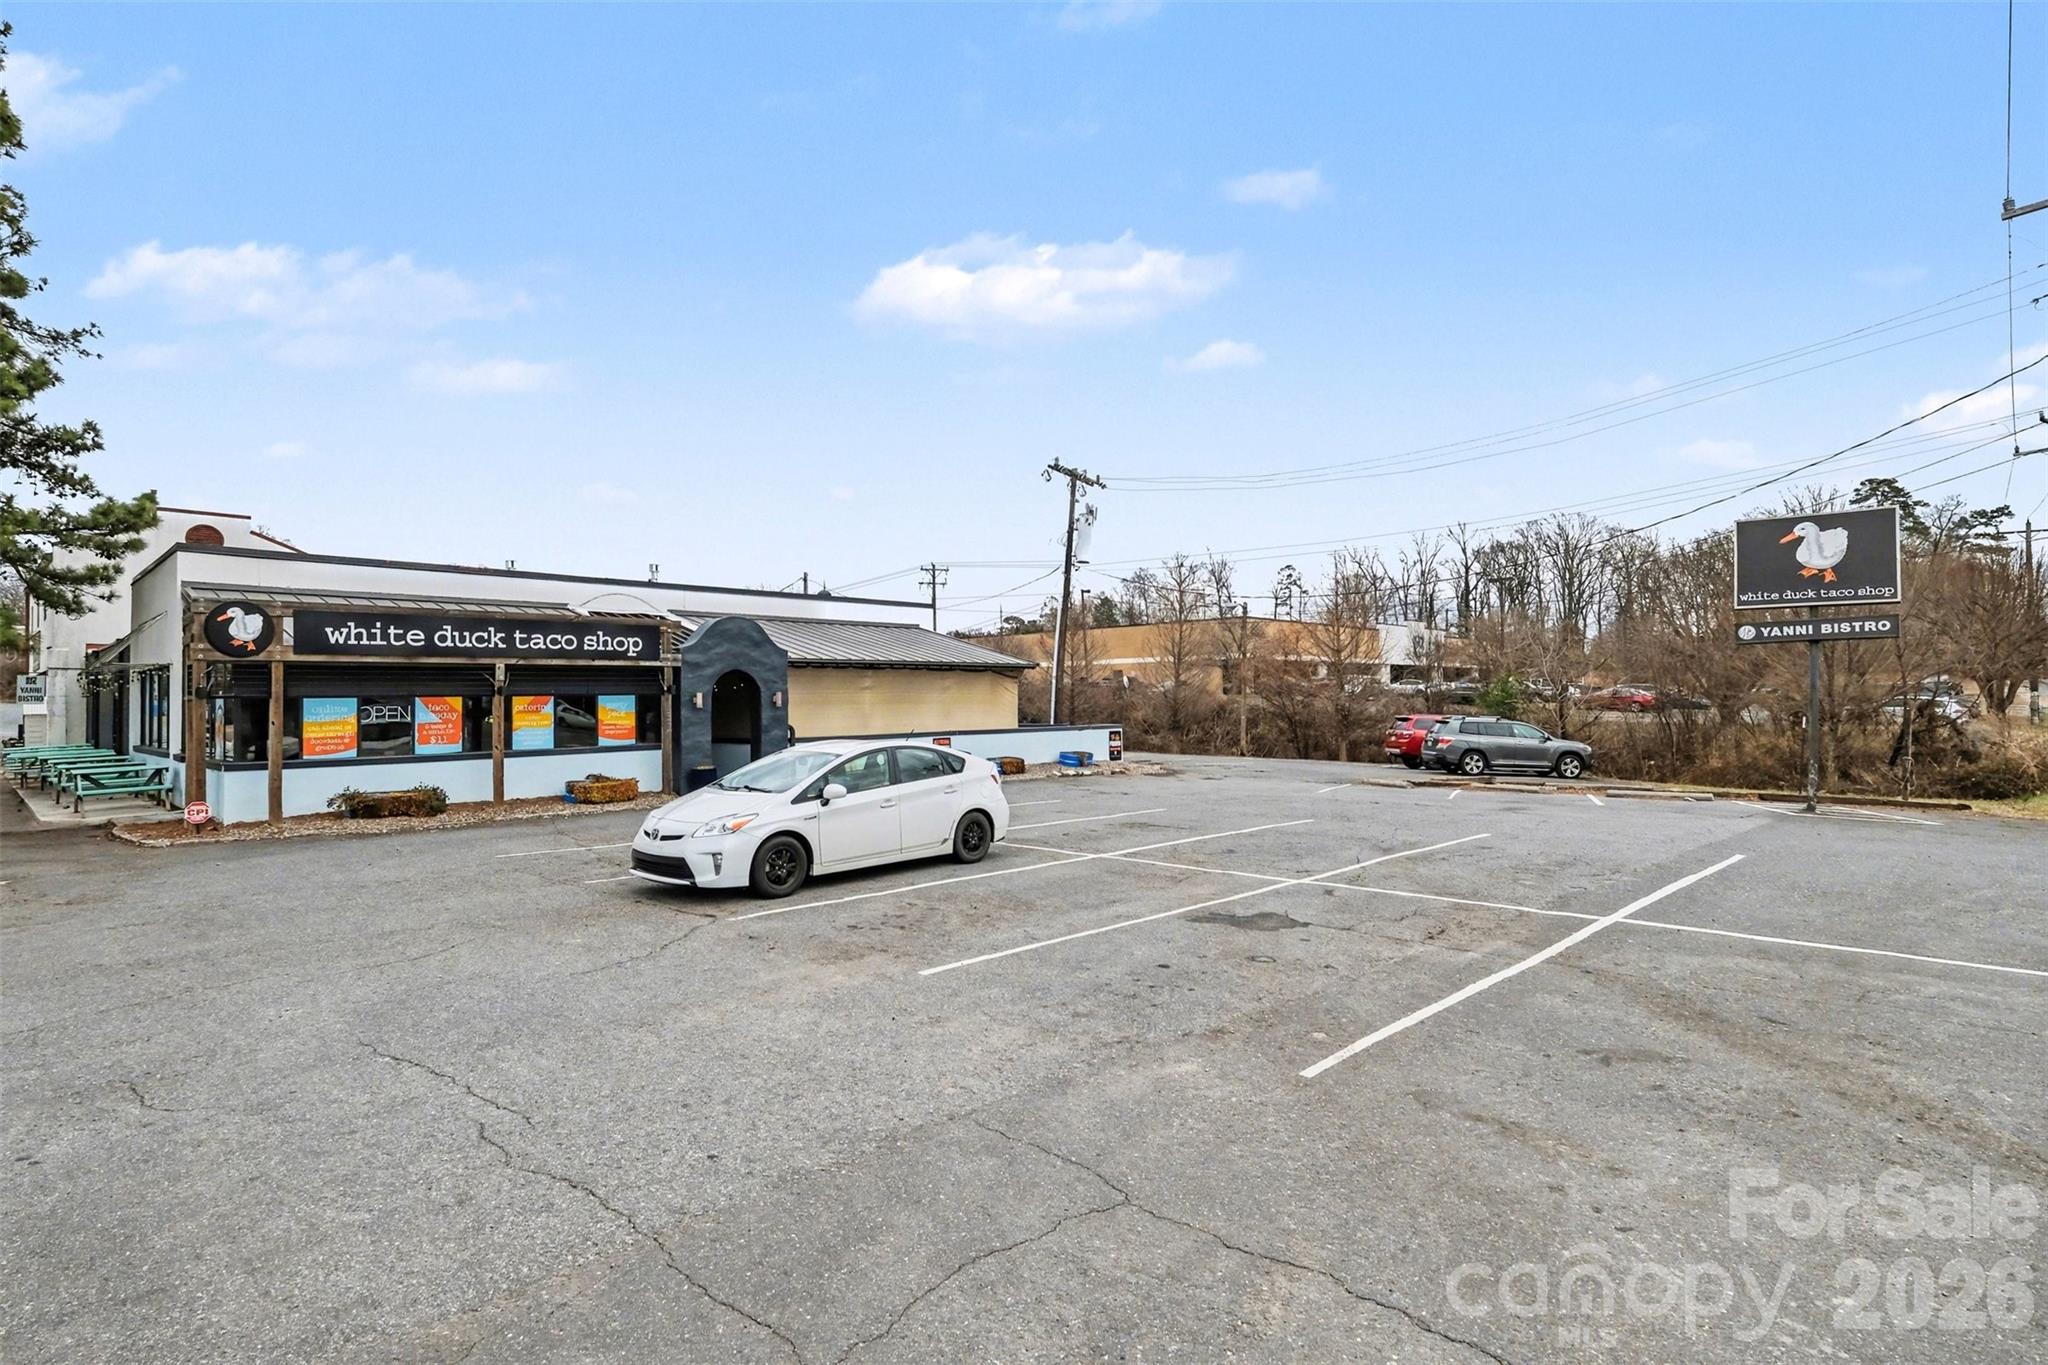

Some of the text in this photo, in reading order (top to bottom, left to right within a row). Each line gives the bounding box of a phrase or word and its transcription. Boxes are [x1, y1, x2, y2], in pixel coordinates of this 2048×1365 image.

[1739, 585, 1895, 601] white duck taco shop
[1760, 620, 1892, 637] YANNI BISTRO
[324, 621, 643, 657] white duck taco shop
[18, 695, 44, 703] BISTRO
[360, 705, 411, 722] OPEN
[428, 703, 450, 712] taco
